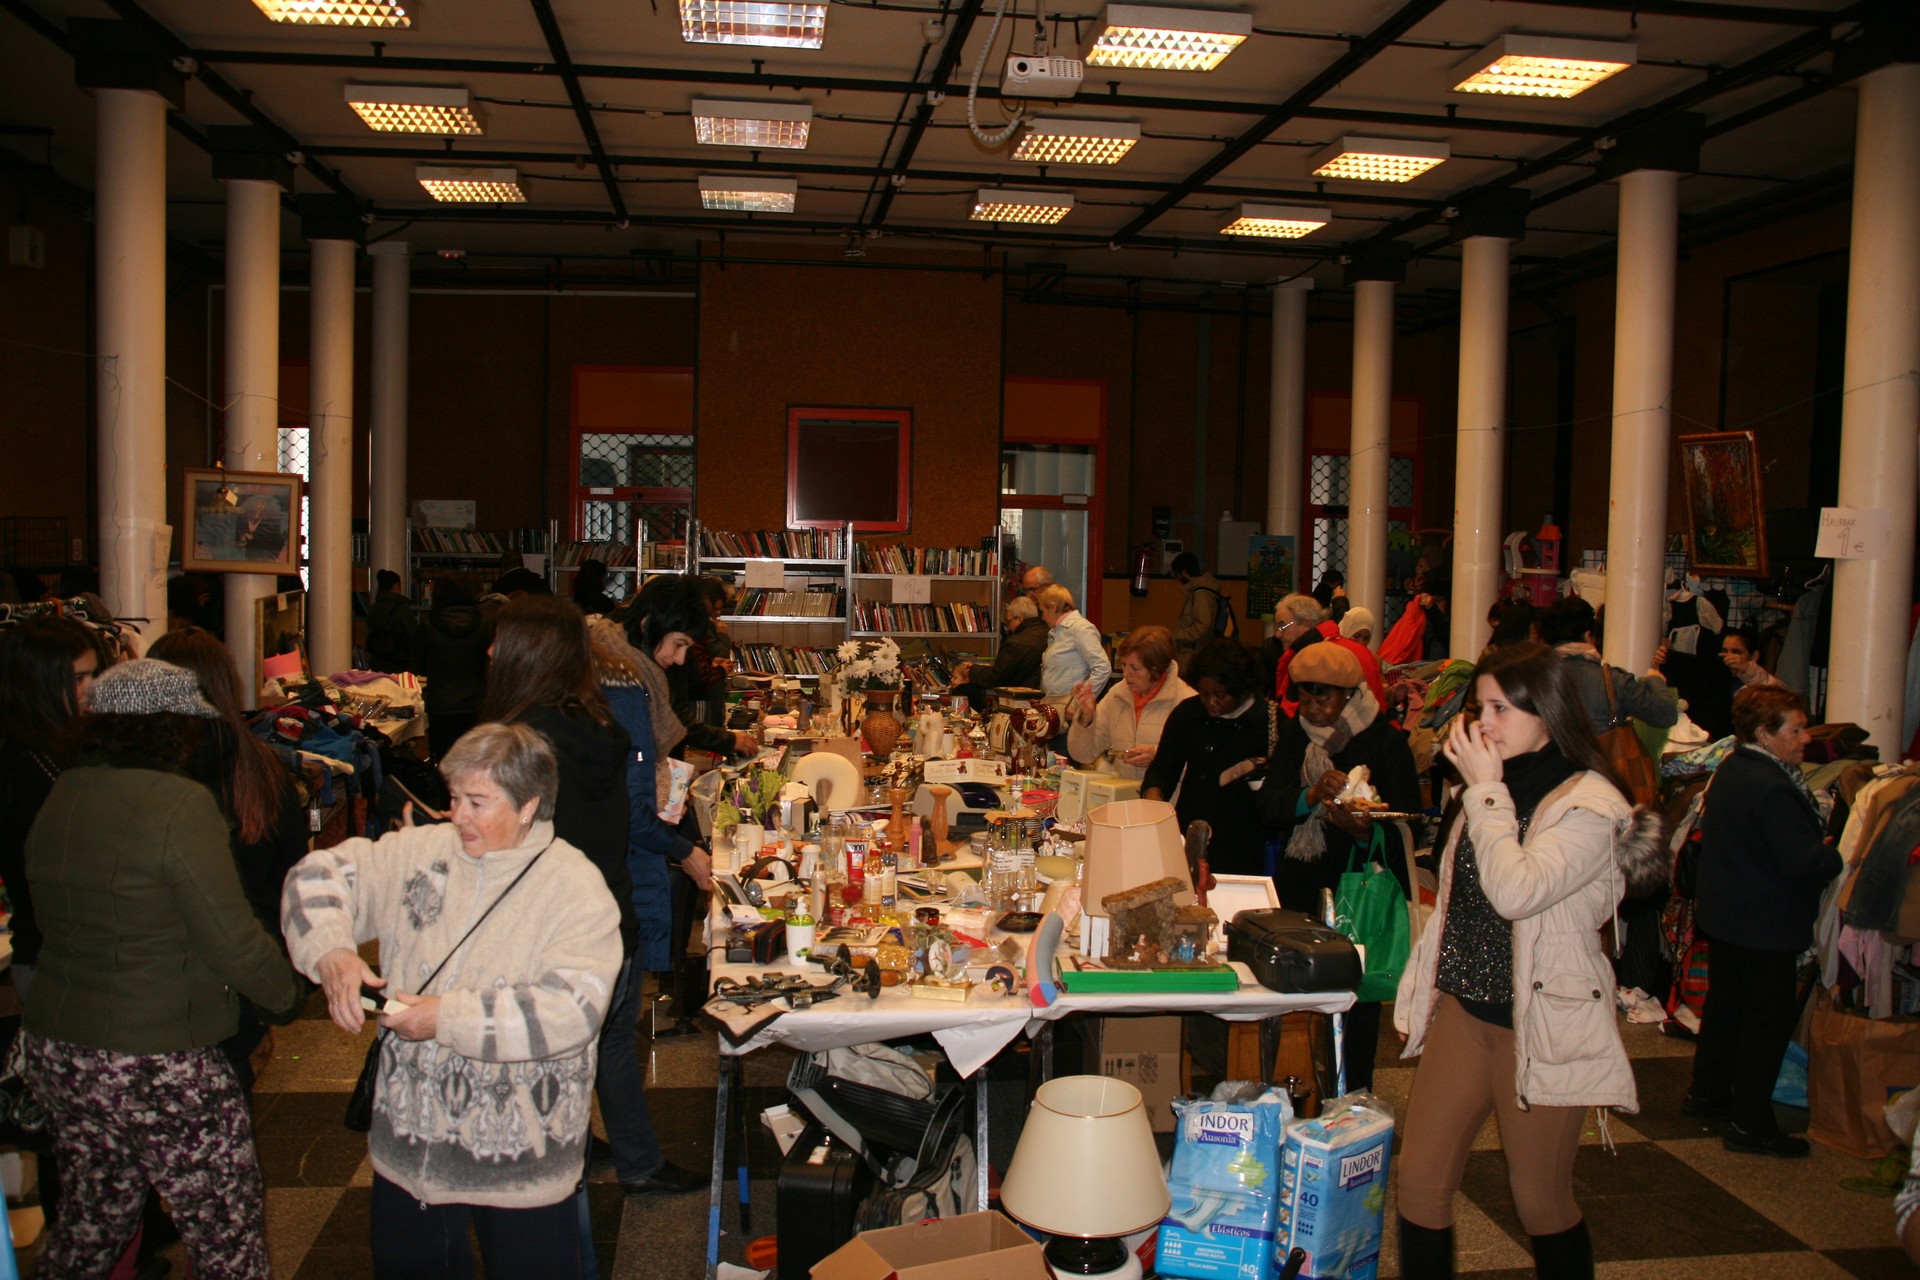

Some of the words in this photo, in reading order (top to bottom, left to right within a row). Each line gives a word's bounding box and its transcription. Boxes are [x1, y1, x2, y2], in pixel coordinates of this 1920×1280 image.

[1201, 1132, 1237, 1144] Ausonia
[1343, 1150, 1380, 1178] LINDOR
[1300, 1191, 1319, 1207] 40
[1241, 1263, 1256, 1274] 40
